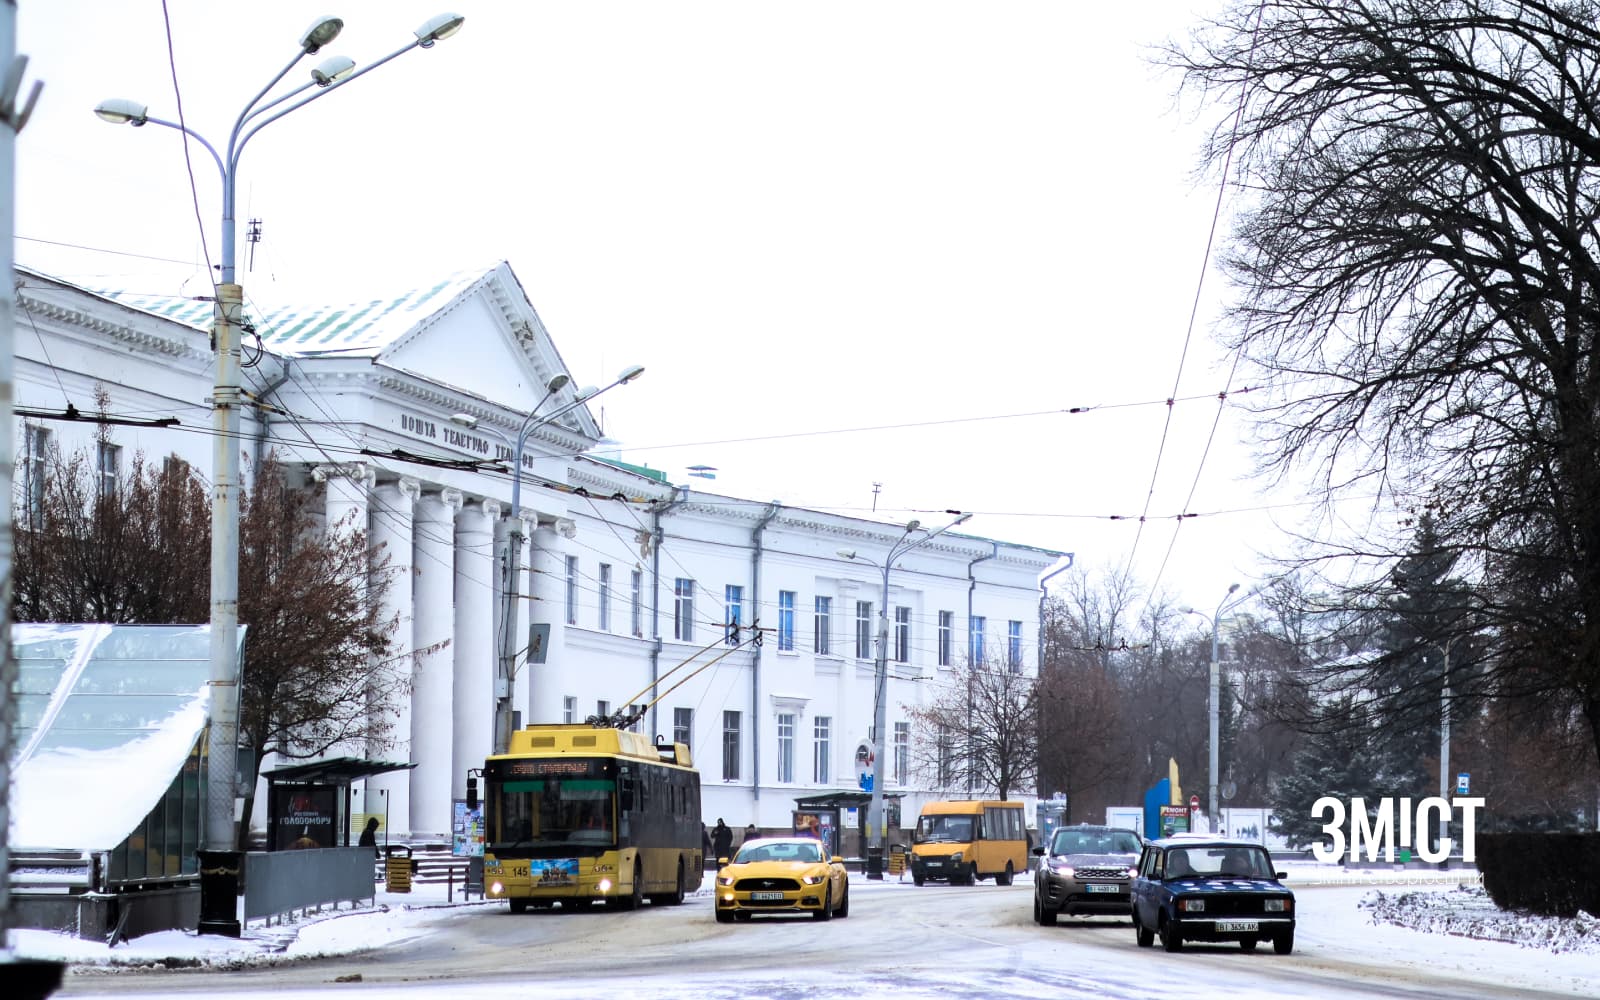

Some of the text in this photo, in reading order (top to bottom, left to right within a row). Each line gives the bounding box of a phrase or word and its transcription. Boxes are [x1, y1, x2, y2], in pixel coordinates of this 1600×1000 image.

[401, 414, 533, 469] ПОШТА ТЕЛЕГРАФ ТЕЛОН
[279, 816, 332, 825] ГОЛОДОМОРУ
[513, 866, 528, 877] 145
